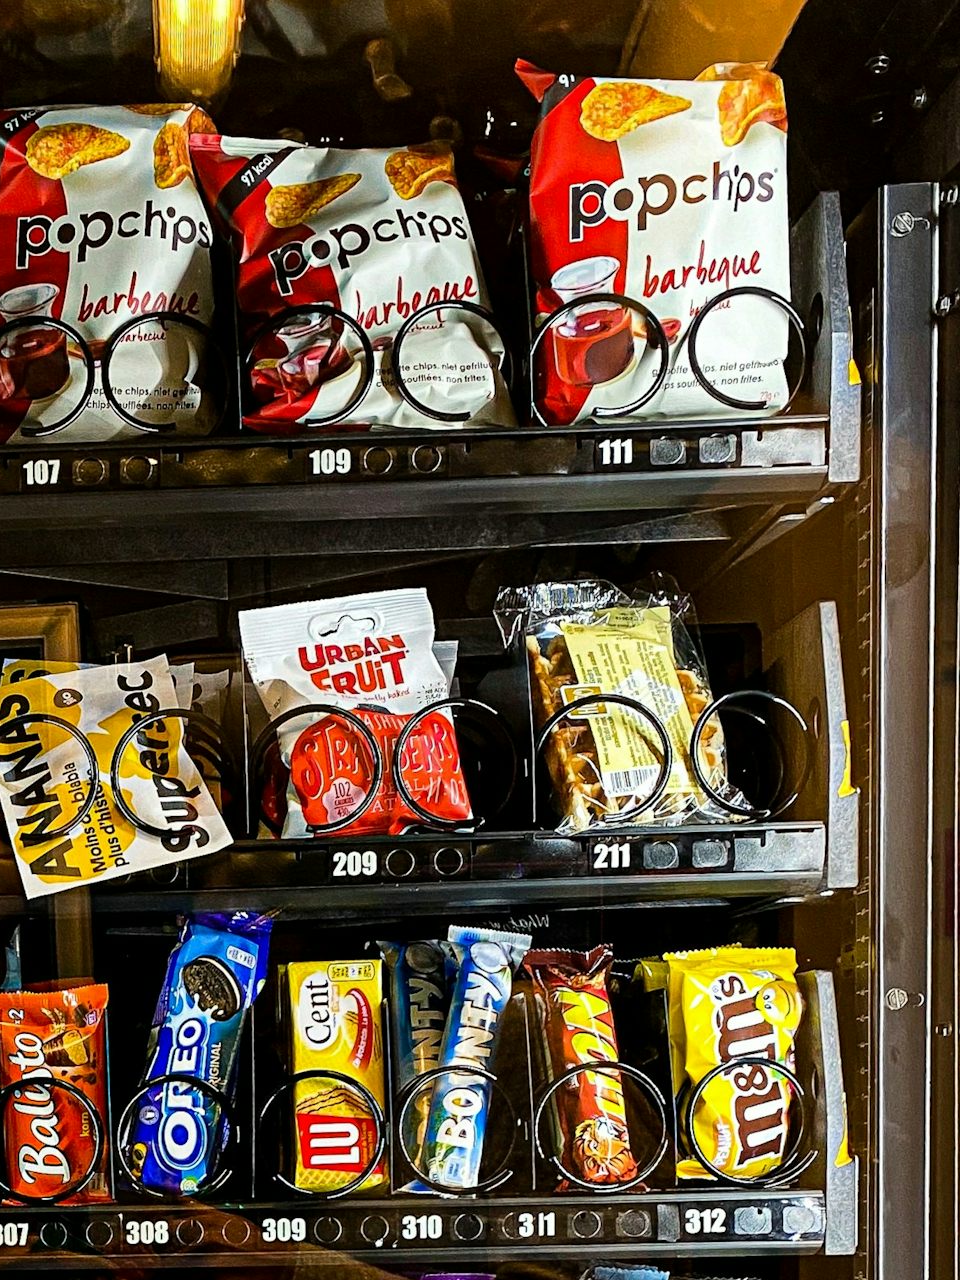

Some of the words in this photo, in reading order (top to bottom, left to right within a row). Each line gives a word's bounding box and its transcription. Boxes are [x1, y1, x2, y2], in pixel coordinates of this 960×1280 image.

[240, 170, 256, 188] 97
[250, 155, 275, 179] kcal
[569, 160, 778, 244] popchips
[16, 199, 214, 270] popchips
[268, 207, 470, 296] popchips
[642, 240, 762, 300] barbeque
[78, 270, 201, 333] barbeque
[355, 274, 478, 332] barbeque
[309, 449, 351, 475] 109
[599, 439, 633, 465] 111
[23, 460, 60, 485] 107
[297, 634, 407, 673] URBAN
[310, 653, 408, 695] FRUIT
[116, 670, 210, 853] supersec
[62, 761, 86, 804] blabla
[332, 780, 352, 799] 102
[83, 824, 107, 873] Moins
[107, 834, 130, 868] plus
[333, 850, 378, 877] 209
[593, 843, 631, 869] 211
[305, 978, 334, 1046] Cent
[436, 970, 503, 1149] BOUNTY
[10, 1030, 72, 1186] Balisto
[163, 1016, 206, 1163] OREO
[78, 1110, 91, 1139] korn
[309, 1121, 361, 1168] LU
[126, 1221, 169, 1244] 308
[262, 1218, 306, 1243] 309
[402, 1215, 442, 1239] 310
[518, 1212, 556, 1238] 311
[685, 1208, 727, 1234] 312
